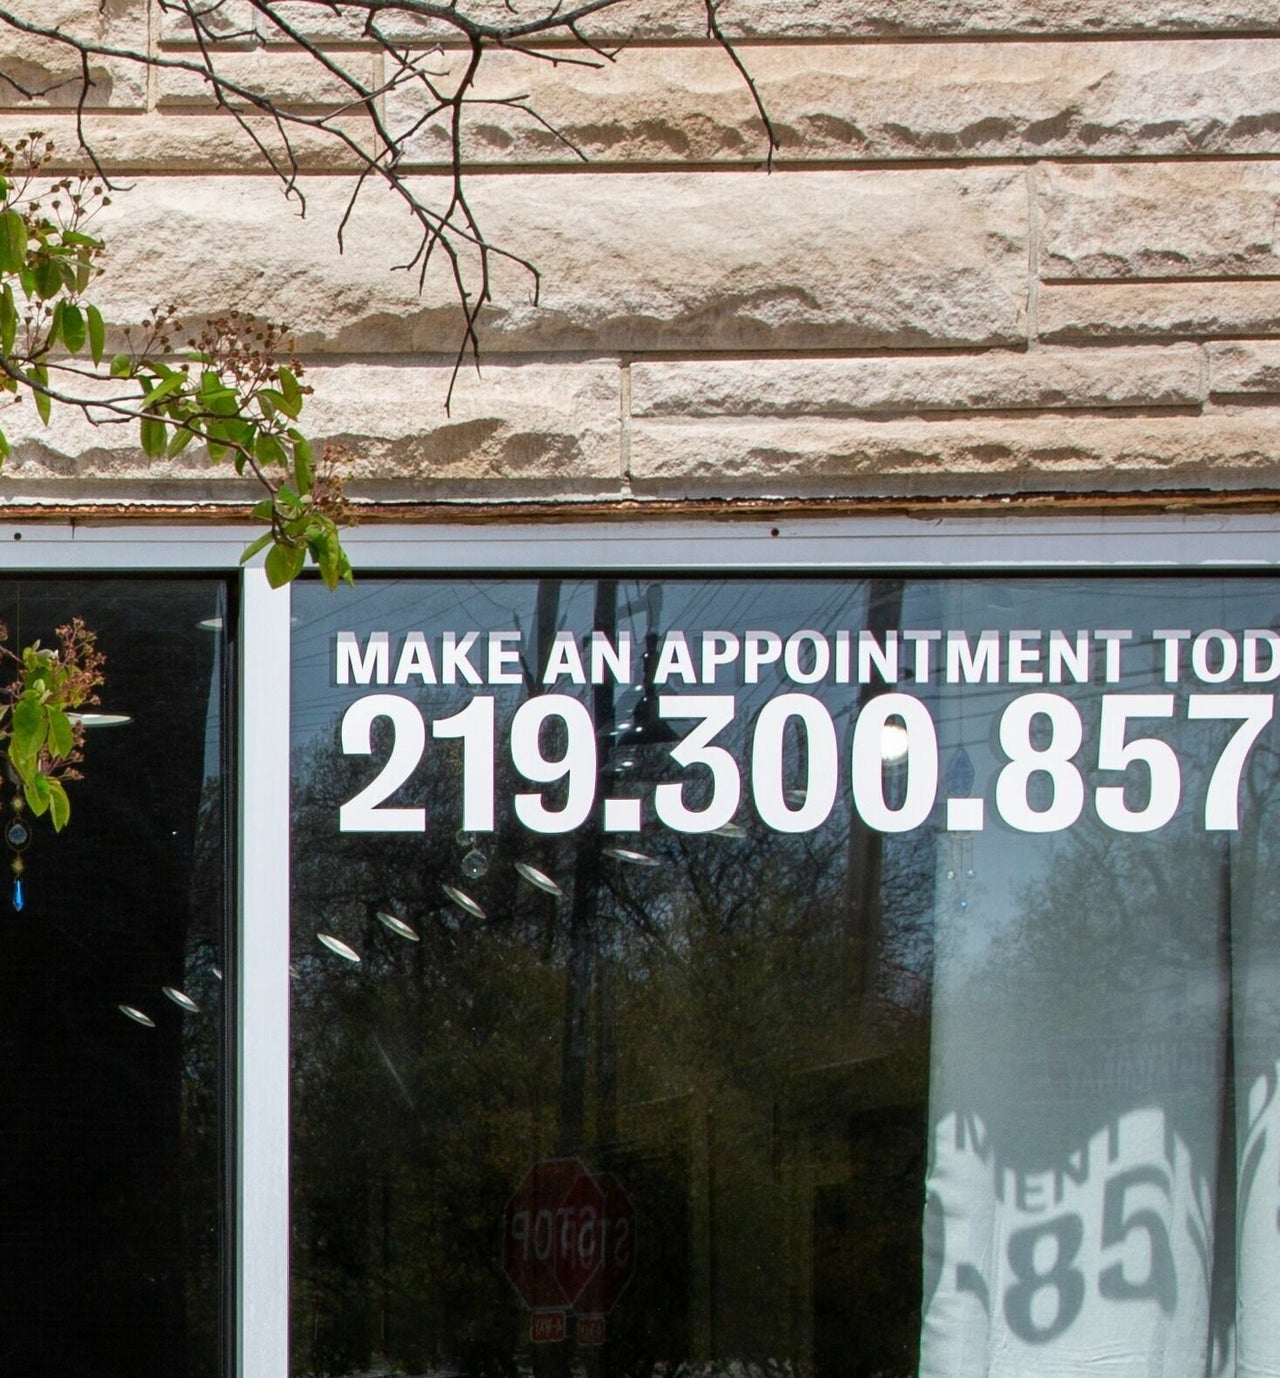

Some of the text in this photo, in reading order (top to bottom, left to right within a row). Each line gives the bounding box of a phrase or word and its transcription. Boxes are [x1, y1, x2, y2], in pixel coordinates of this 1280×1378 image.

[336, 629, 1280, 684] MAKE AN APPOINTMENT TOD
[340, 693, 1275, 833] 219.300.857
